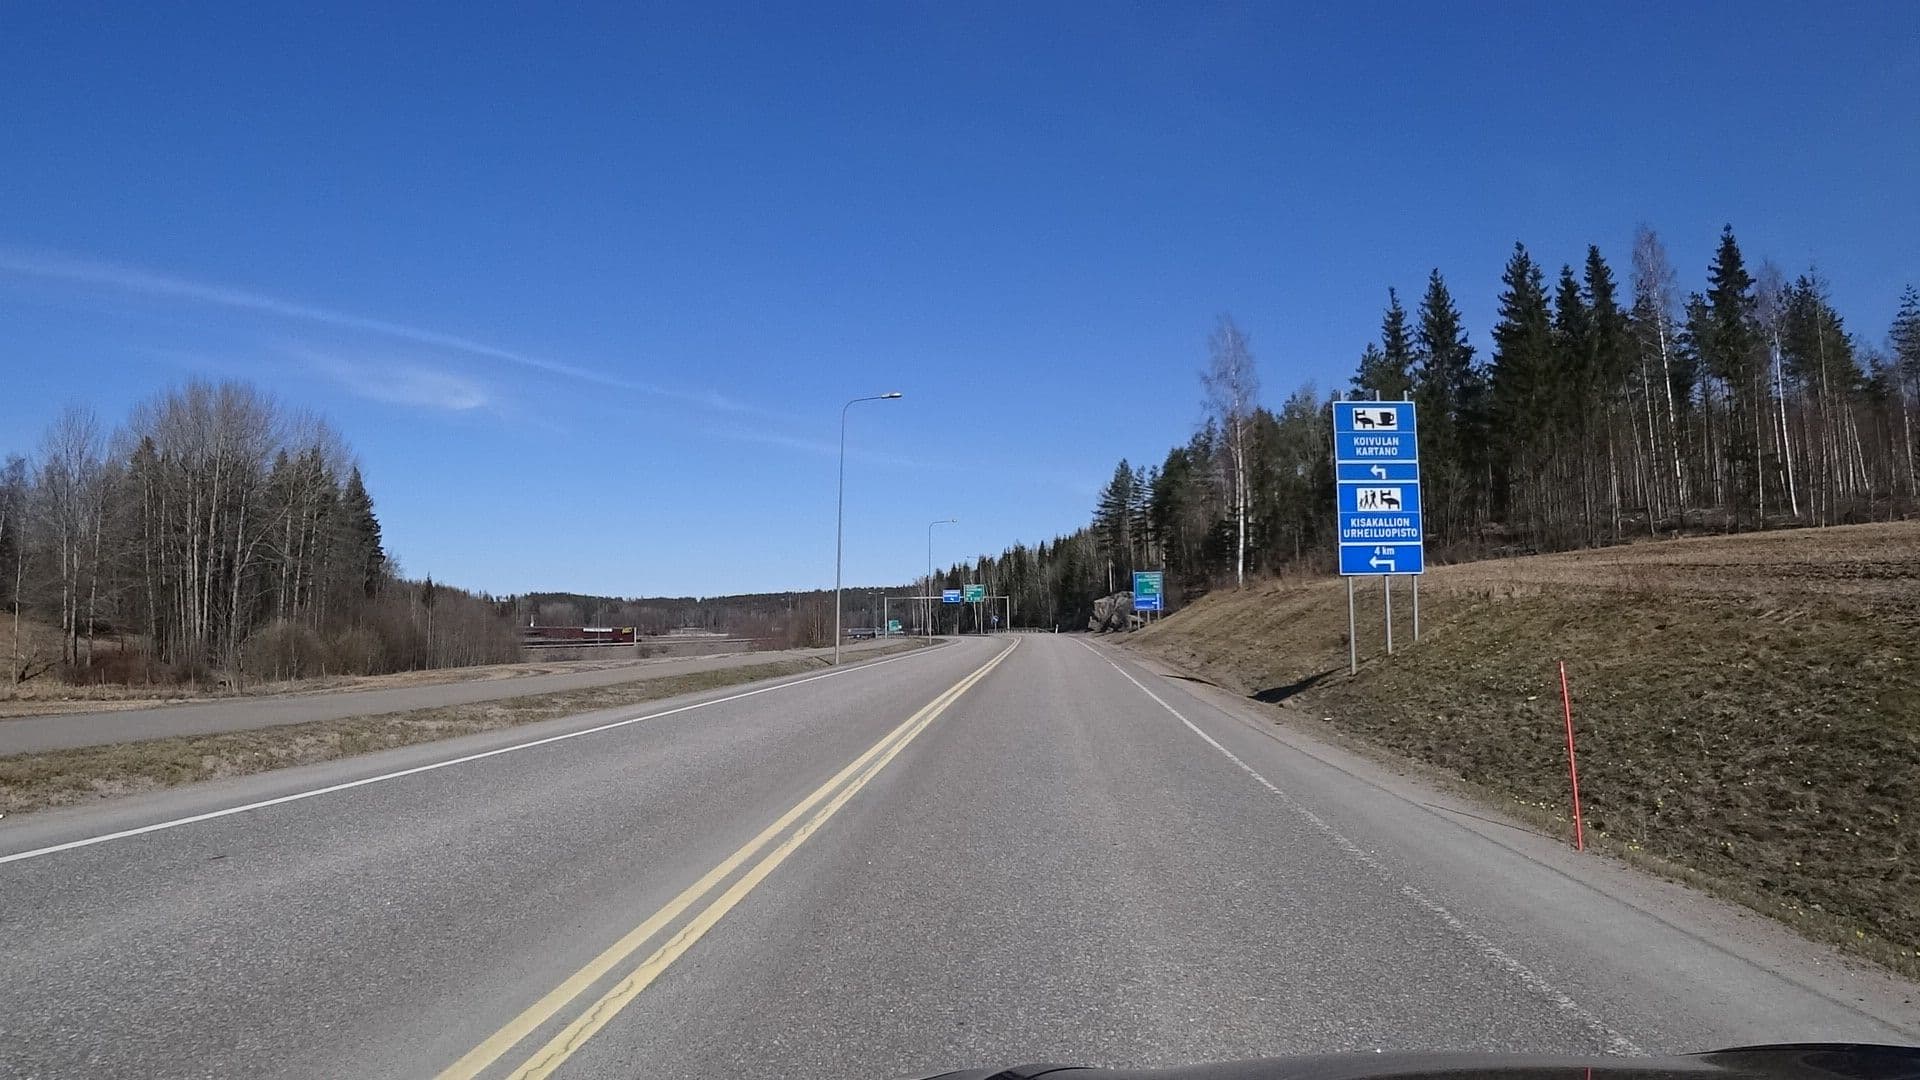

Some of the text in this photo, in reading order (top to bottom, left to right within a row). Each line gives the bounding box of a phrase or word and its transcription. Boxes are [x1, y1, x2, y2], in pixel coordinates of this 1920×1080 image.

[1354, 437, 1399, 446] KOIVULAN
[1356, 447, 1398, 456] KARTANO
[1350, 518, 1410, 527] KISAKALLION
[1343, 528, 1418, 538] URHEILUOPISTO
[1374, 547, 1395, 555] 4 km
